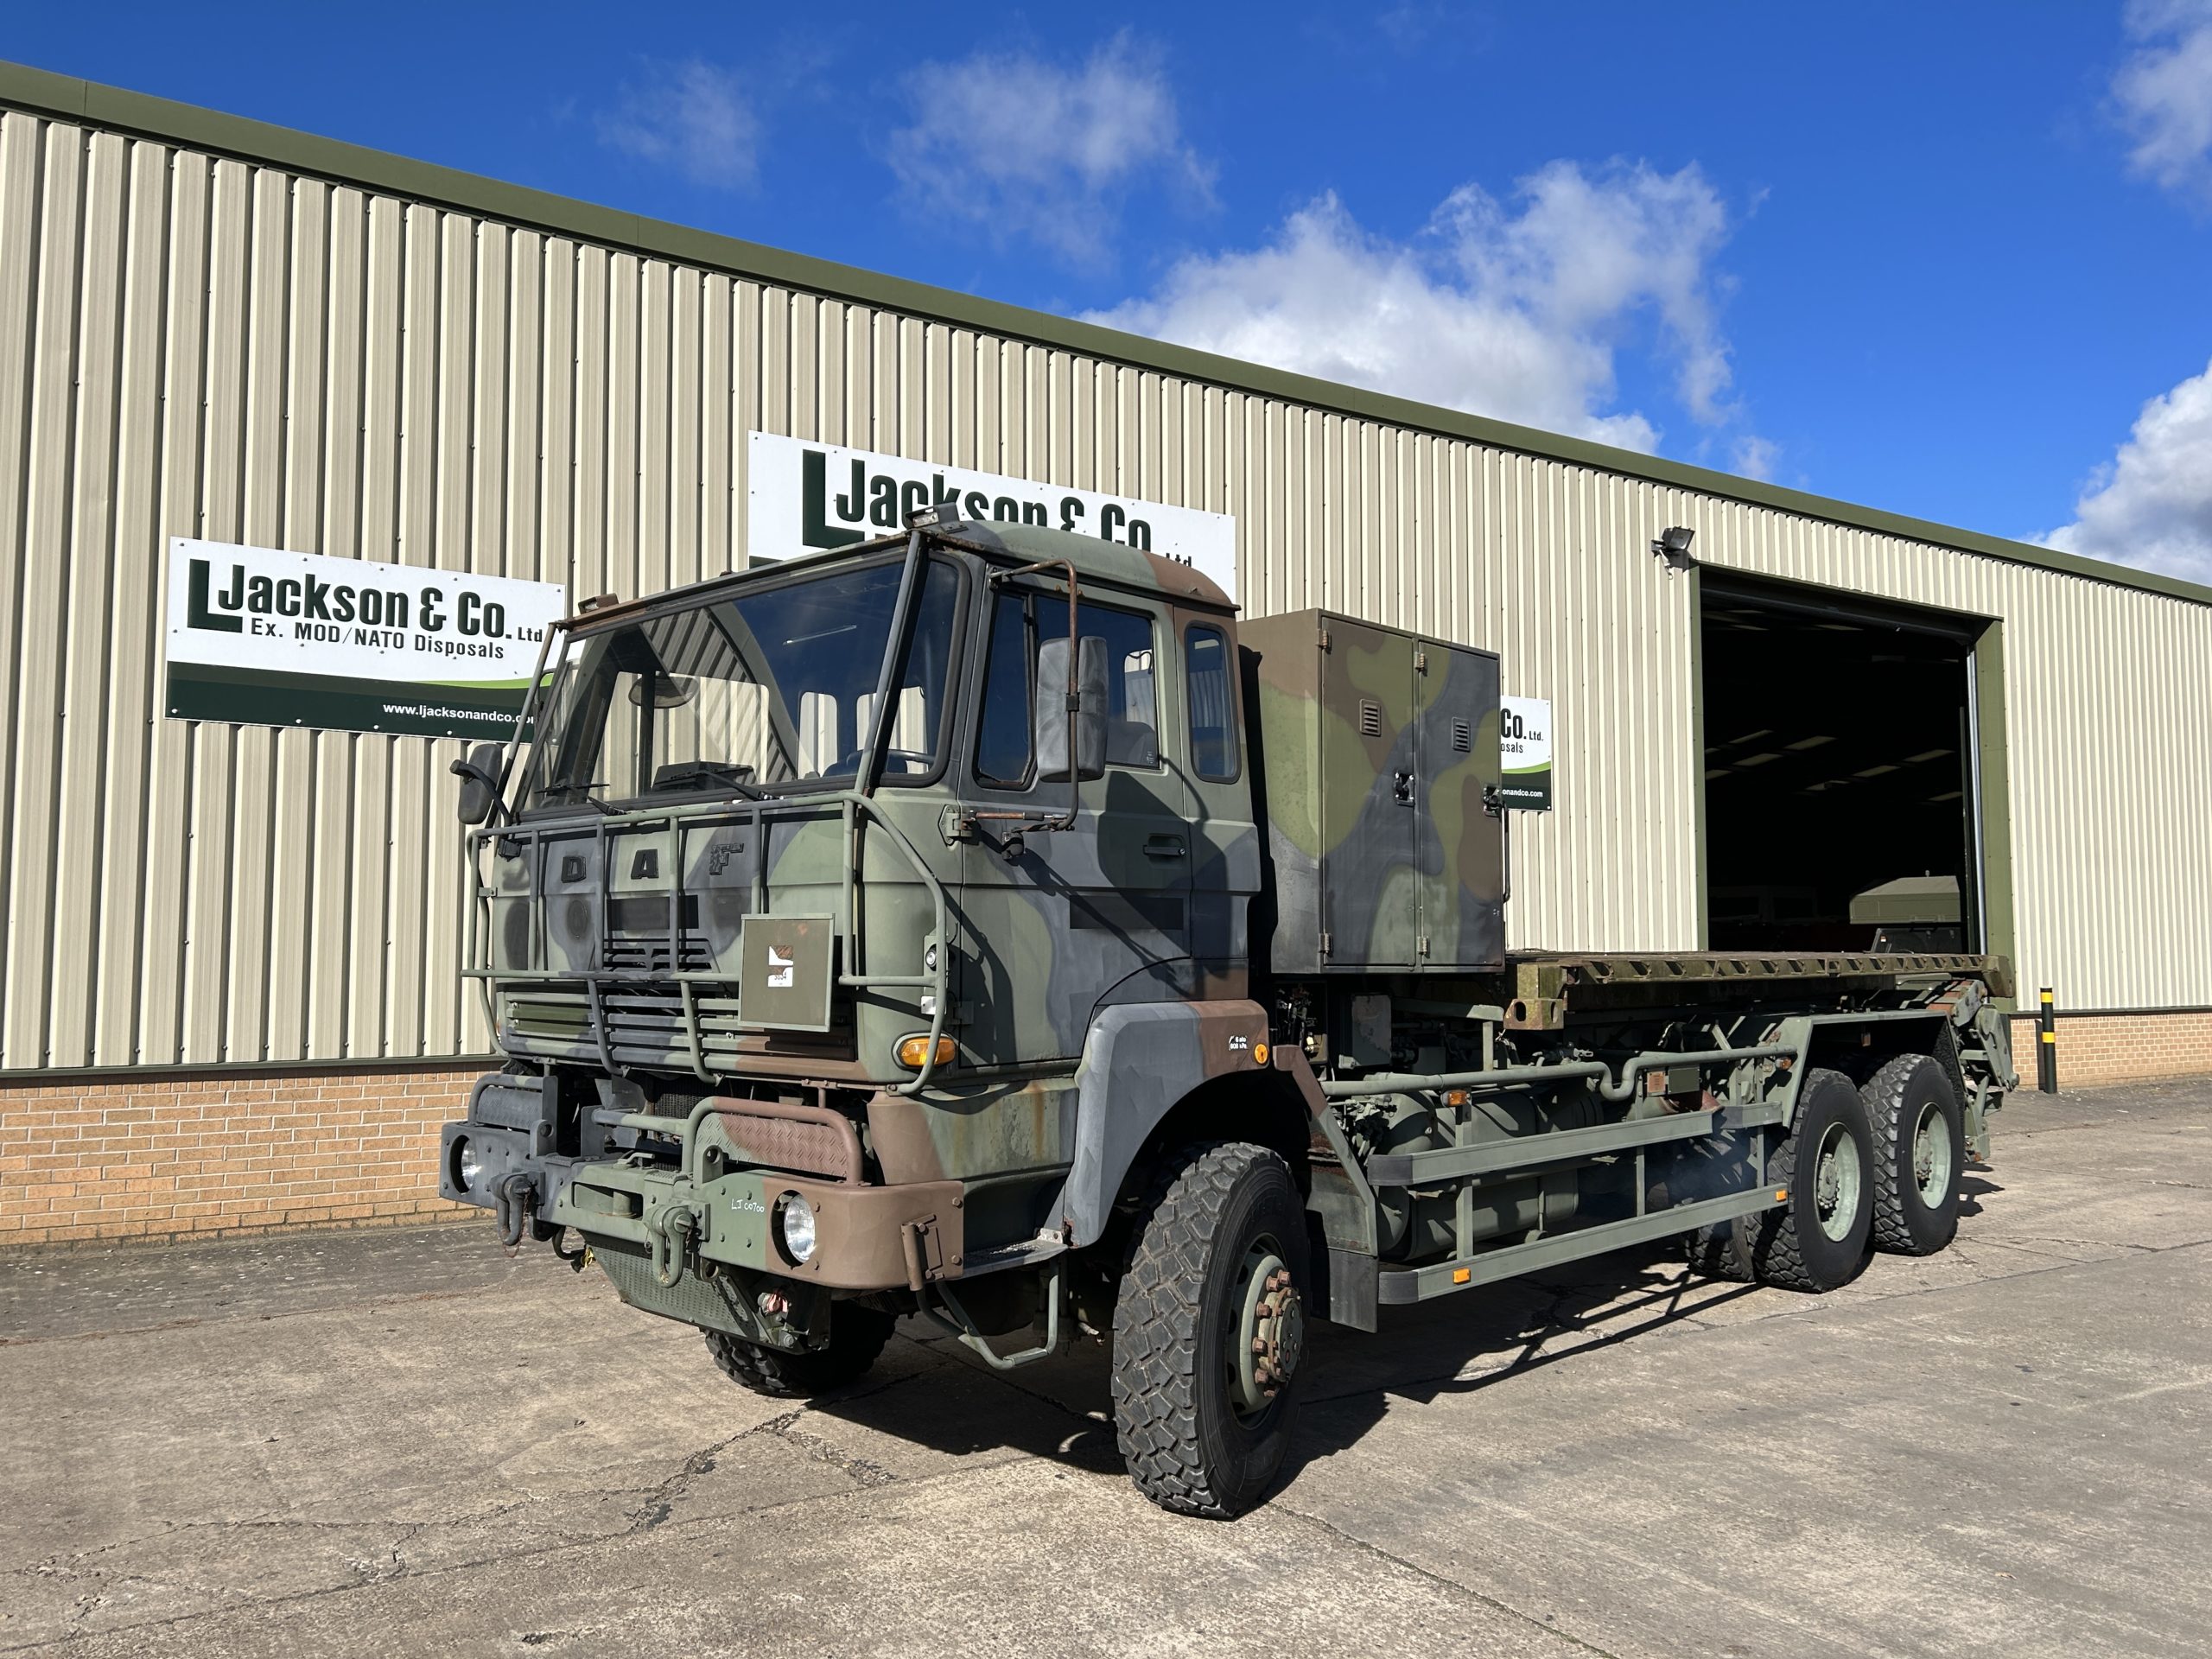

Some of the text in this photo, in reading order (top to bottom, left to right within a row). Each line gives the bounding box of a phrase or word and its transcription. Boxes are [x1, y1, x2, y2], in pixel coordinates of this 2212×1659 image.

[419, 587, 447, 632] &
[457, 591, 512, 639] Co.
[518, 626, 543, 642] Ltd
[251, 618, 505, 659] Ex. MOD/NATO Disposals
[1501, 708, 1527, 739] Co.
[561, 842, 744, 883] DAF
